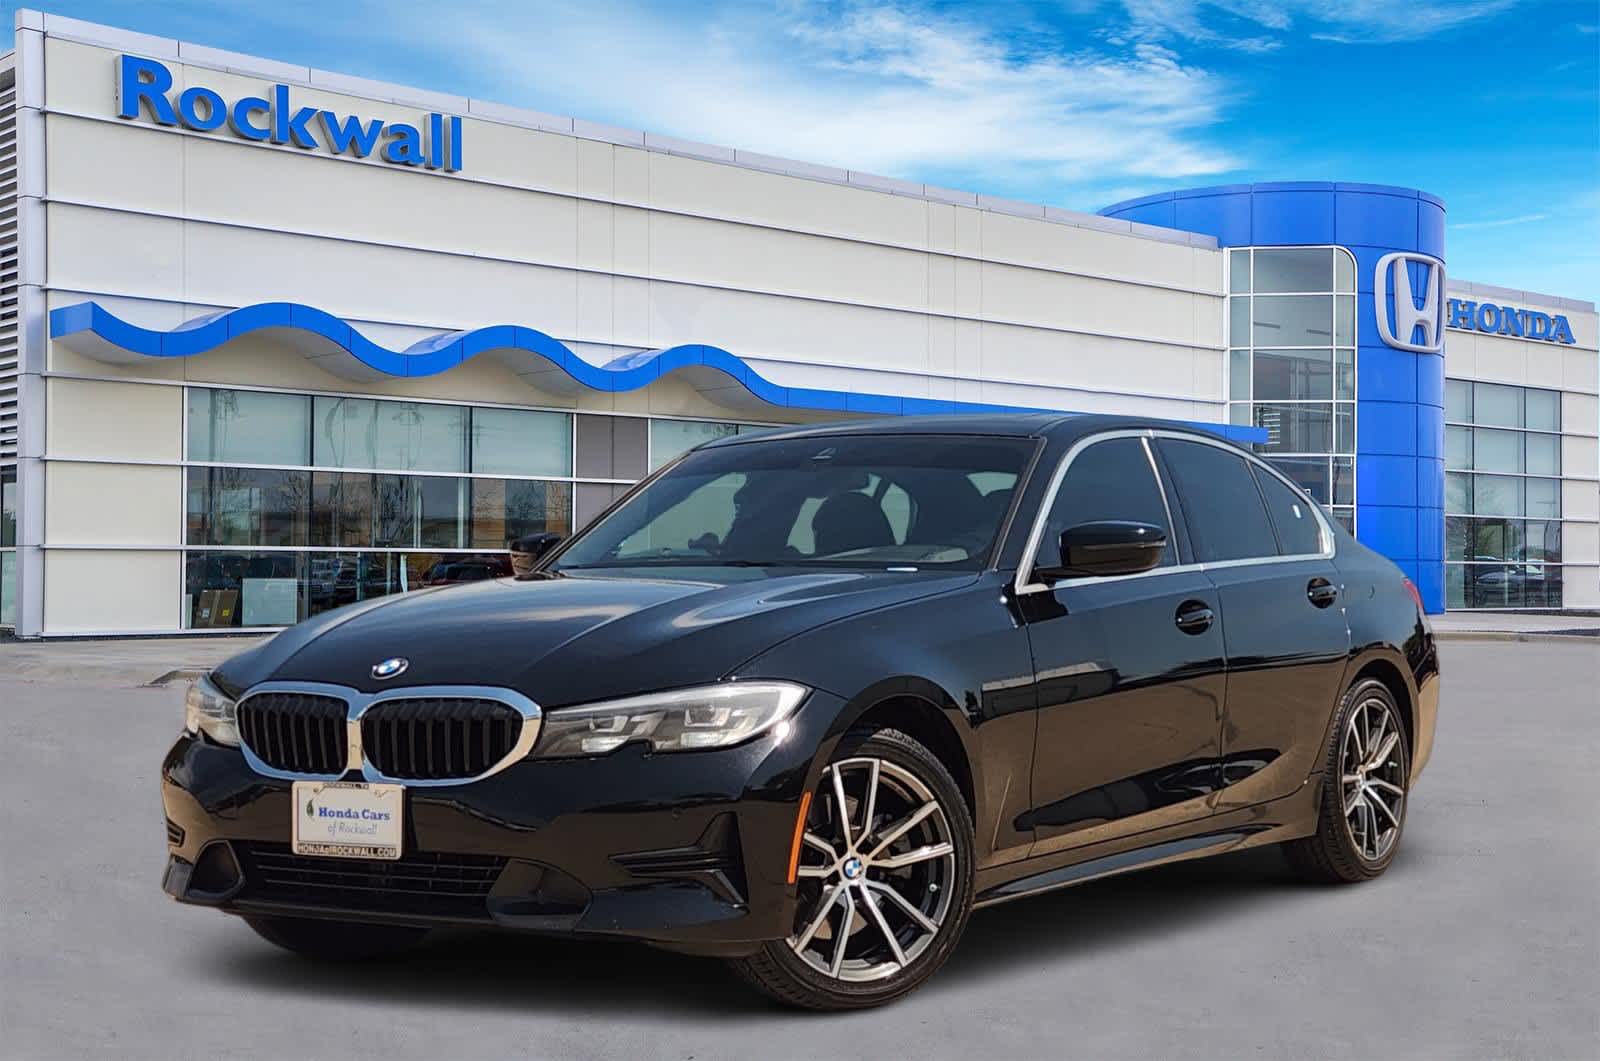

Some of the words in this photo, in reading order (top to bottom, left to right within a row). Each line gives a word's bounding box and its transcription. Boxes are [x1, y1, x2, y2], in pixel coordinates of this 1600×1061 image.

[116, 54, 463, 172] Rockwall
[1447, 298, 1577, 344] HONDA
[319, 806, 359, 819] Honda
[362, 808, 391, 821] Cars
